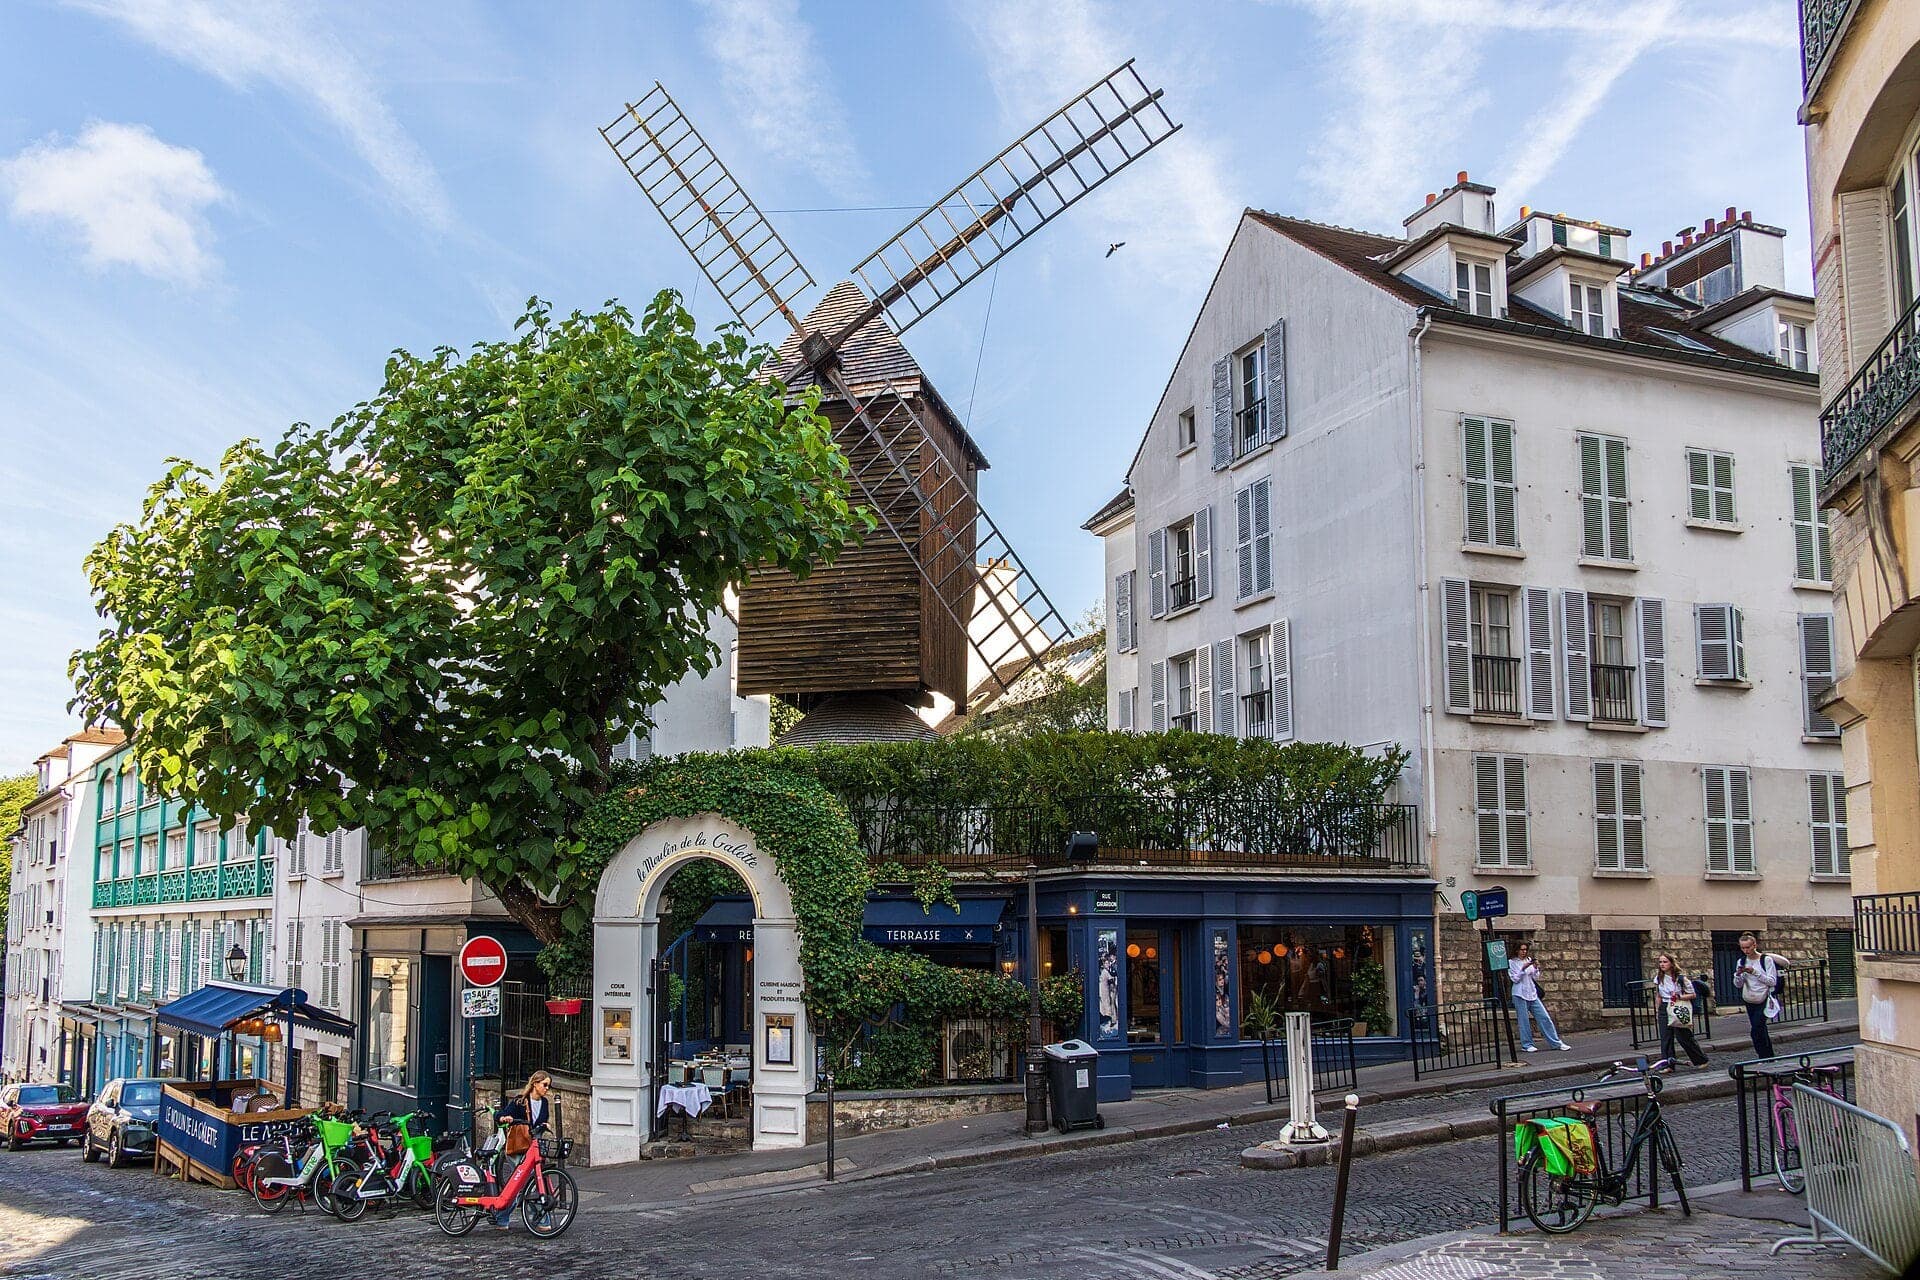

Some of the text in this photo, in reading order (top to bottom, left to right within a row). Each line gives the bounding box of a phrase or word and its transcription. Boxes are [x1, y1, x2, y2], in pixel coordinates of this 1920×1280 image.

[643, 841, 678, 873] Moulin
[680, 836, 692, 849] de
[695, 831, 707, 846] la
[712, 833, 758, 869] Galette
[739, 930, 754, 940] RE
[886, 930, 942, 941] TERRASSE
[471, 989, 493, 998] SAUF
[171, 1108, 186, 1131] MOULIN
[191, 1118, 198, 1138] LA
[241, 1125, 260, 1141] LE
